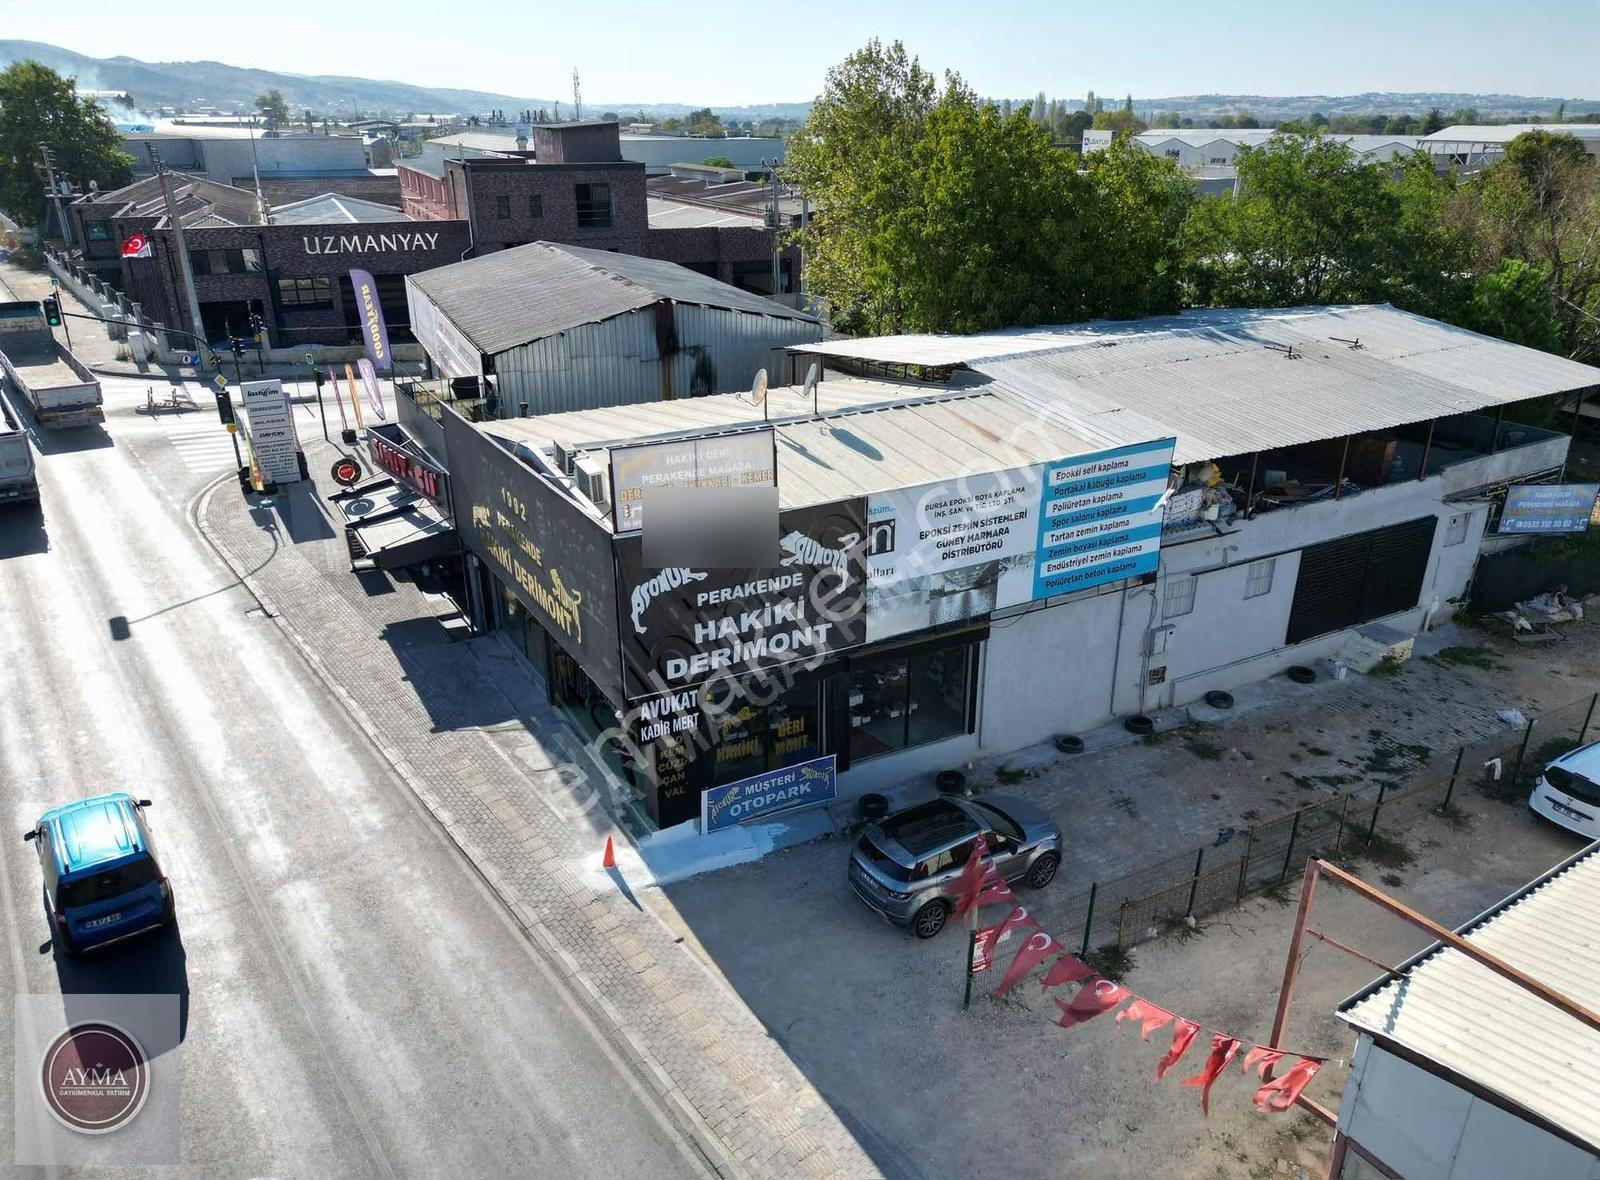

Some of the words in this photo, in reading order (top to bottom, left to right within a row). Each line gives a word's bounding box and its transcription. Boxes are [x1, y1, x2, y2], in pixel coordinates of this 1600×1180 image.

[303, 232, 439, 255] UZMANYAY
[1056, 469, 1082, 480] Epoksi
[1083, 465, 1098, 475] self
[1098, 460, 1128, 472] kaplama
[1054, 483, 1085, 497] Portakal
[1087, 477, 1115, 489] kabuğu
[1116, 472, 1147, 484] kaplama
[501, 488, 526, 521] 1992
[925, 501, 948, 511] BURSA
[975, 493, 993, 501] BOYA
[994, 487, 1025, 498] KAPLAMA
[1052, 498, 1090, 512] Poliüretan
[1092, 492, 1123, 504] kaplama
[919, 523, 951, 540] EPOKSİ
[952, 519, 979, 533] ZEMİN
[980, 508, 1028, 527] SİSTEMLERİ
[1051, 517, 1070, 528] Spor
[1071, 511, 1095, 523] salonu
[1096, 505, 1127, 518] kaplama
[936, 536, 965, 549] GÜNEY
[967, 526, 1010, 542] MARMARA
[1050, 530, 1075, 542] Tartan
[1076, 526, 1098, 537] zemin
[1099, 520, 1130, 532] kaplama
[942, 539, 1004, 561] DİSTRİBÜTÖRÜ
[1047, 557, 1089, 572] Endüstriyel
[1090, 552, 1112, 562] zemin
[1113, 544, 1143, 557] kaplama
[1048, 547, 1072, 558] Zemin
[1099, 534, 1129, 547] kaplama
[1045, 574, 1083, 588] Poliüretan
[1084, 569, 1106, 579] beton
[1107, 562, 1137, 575] kaplama
[514, 558, 572, 636] DERİMONT
[697, 573, 803, 606] PERAKENDE
[694, 595, 805, 644] HAKİKİ
[667, 622, 833, 681] DERİMONT
[640, 689, 698, 721] AVUKAT
[641, 718, 670, 742] KADİR
[673, 712, 699, 732] MERT
[745, 771, 795, 796] MÜŞTERİ
[730, 782, 811, 817] OTOPARK
